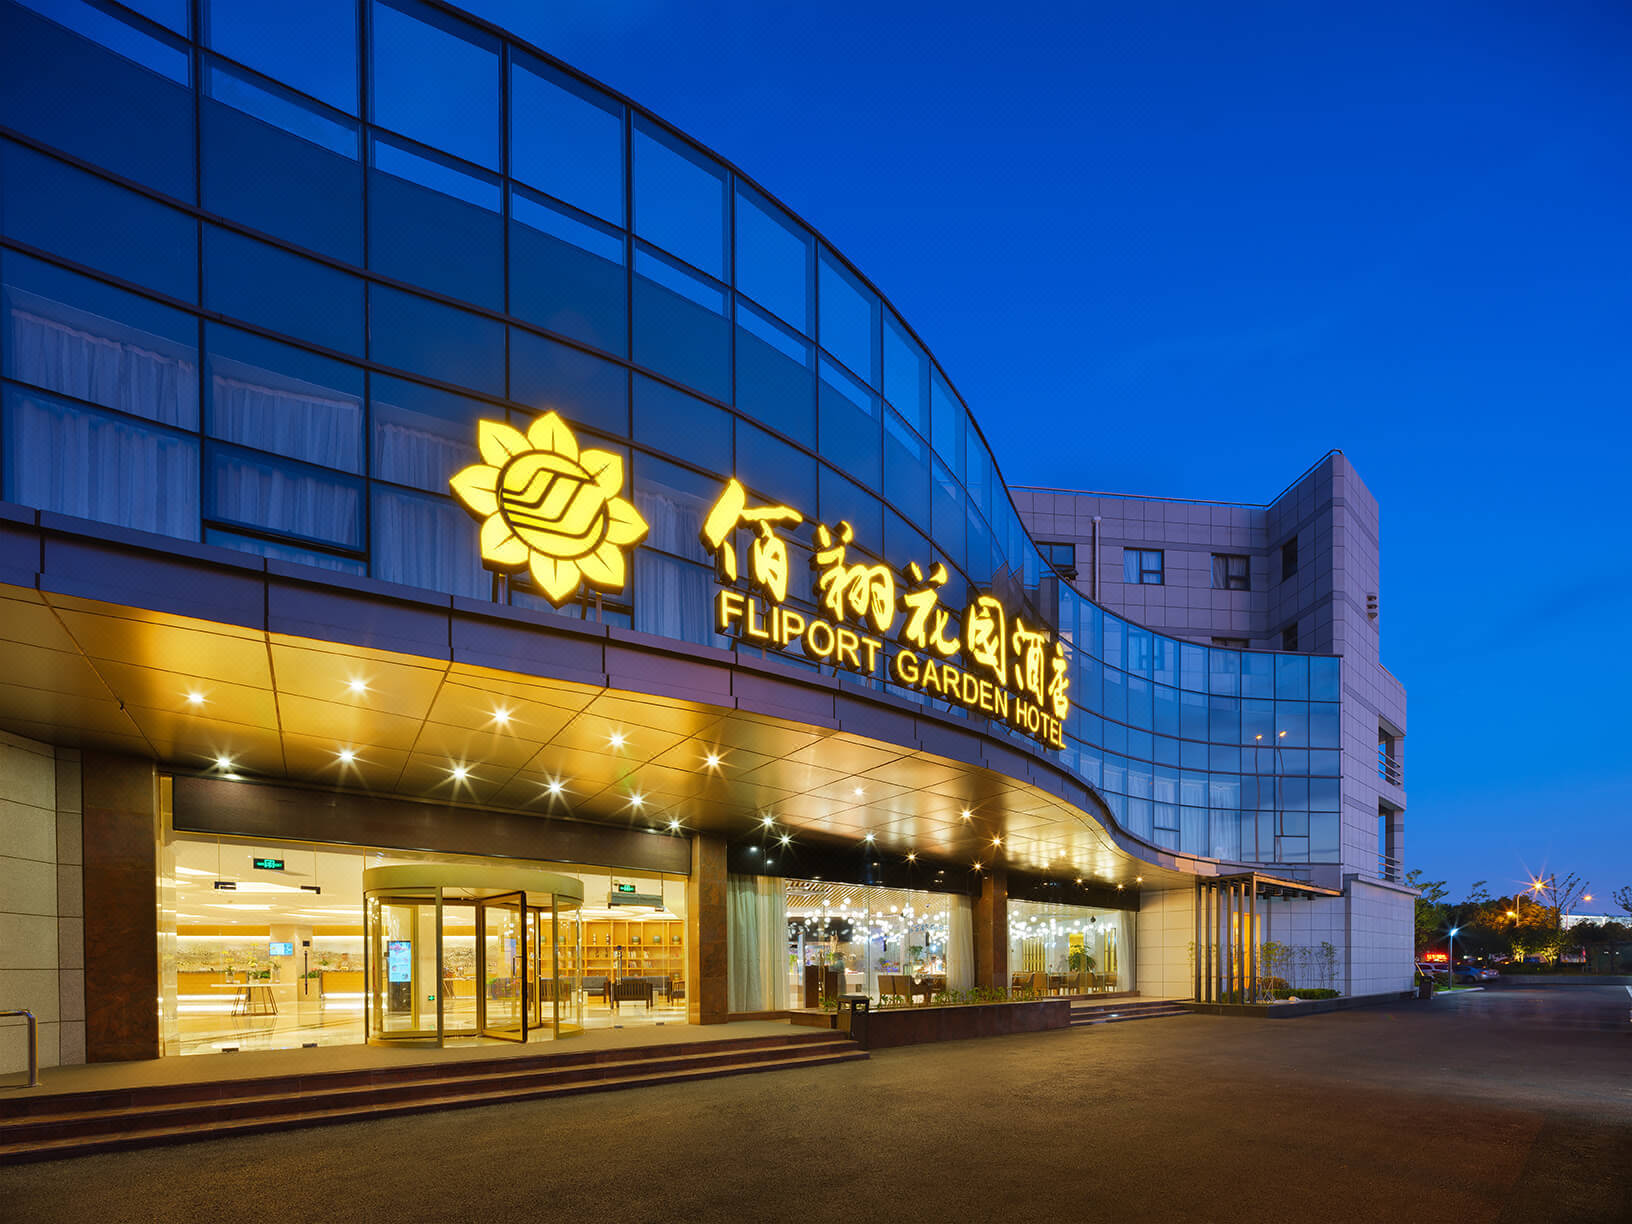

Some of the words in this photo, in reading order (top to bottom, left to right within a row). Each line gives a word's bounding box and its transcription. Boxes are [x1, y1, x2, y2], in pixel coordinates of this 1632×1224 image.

[720, 590, 883, 672] FLIPORT
[896, 649, 1008, 718] GARDEN
[1015, 700, 1067, 750] HOTEL
